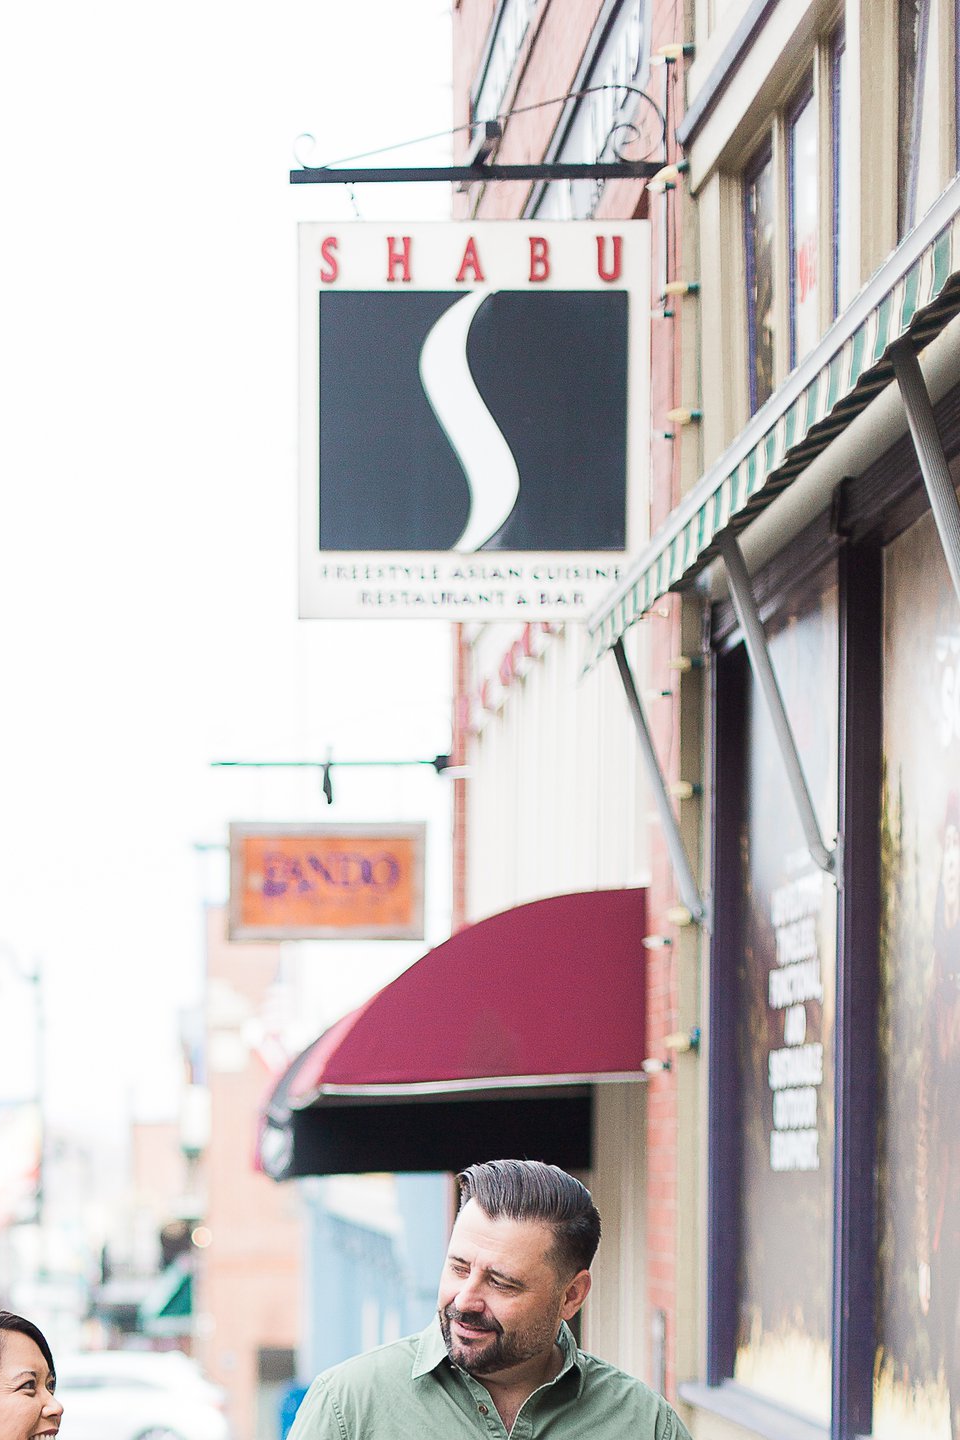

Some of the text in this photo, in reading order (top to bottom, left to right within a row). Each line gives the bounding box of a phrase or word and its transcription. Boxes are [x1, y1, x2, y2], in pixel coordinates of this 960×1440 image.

[319, 235, 623, 283] SHABU
[321, 565, 440, 581] FREESTYLE
[449, 565, 524, 581] ASIAN
[360, 591, 586, 606] RESTAURANT & BAR
